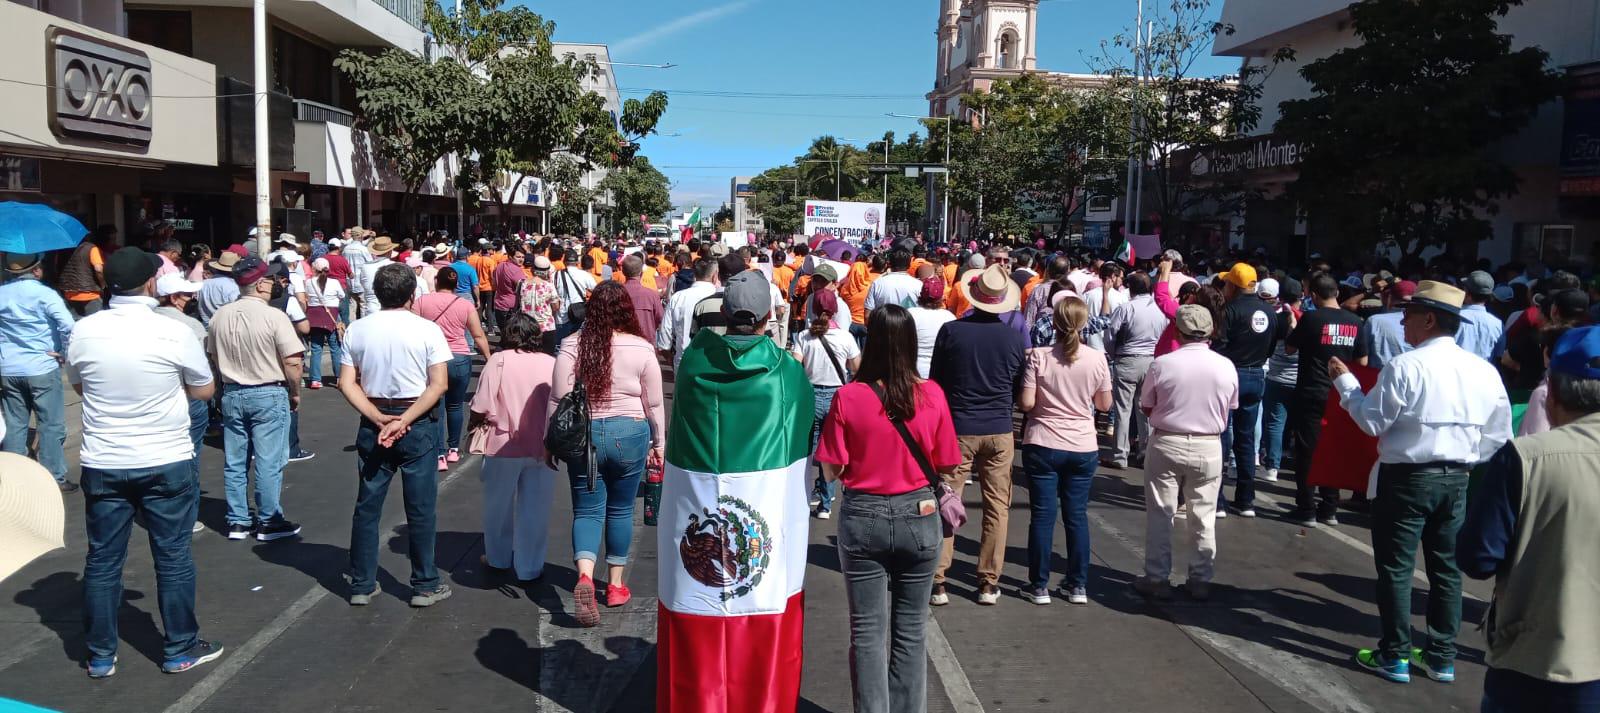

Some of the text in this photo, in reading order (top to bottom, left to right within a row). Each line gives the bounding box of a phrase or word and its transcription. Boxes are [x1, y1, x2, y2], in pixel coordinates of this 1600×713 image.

[64, 58, 150, 121] OXXO
[1258, 140, 1296, 168] Monte
[1322, 323, 1358, 337] #MIVOTO
